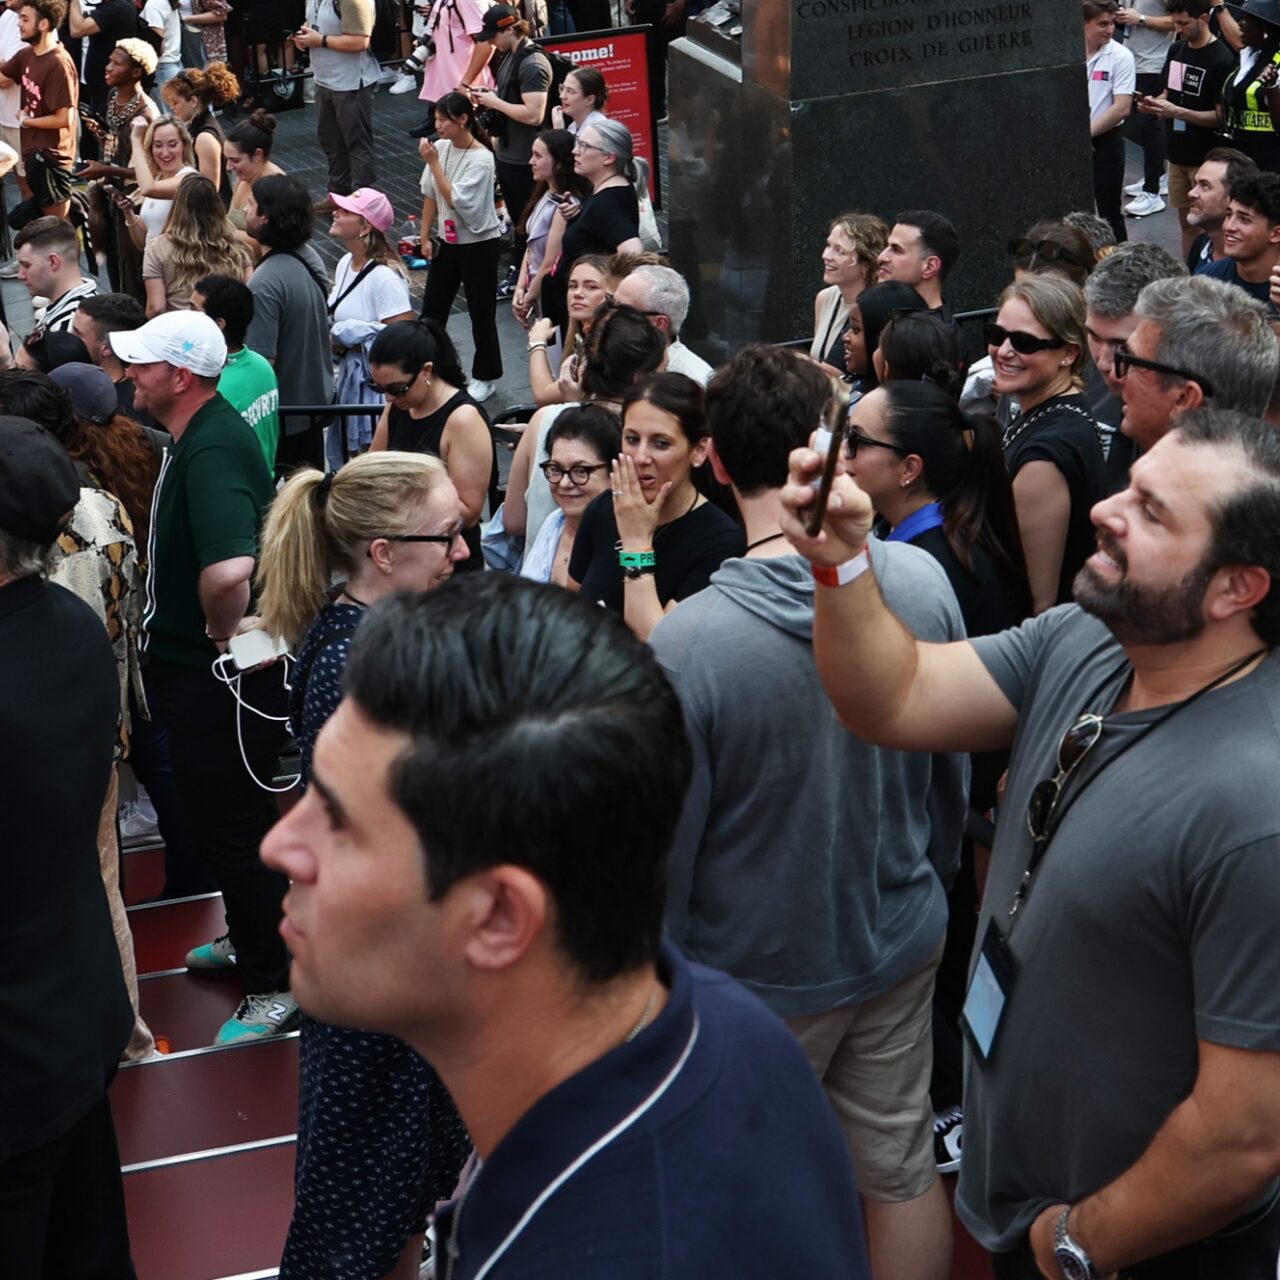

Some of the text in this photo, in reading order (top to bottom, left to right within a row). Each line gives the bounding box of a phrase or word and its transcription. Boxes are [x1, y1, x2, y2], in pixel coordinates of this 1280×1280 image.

[927, 3, 1032, 30] D'HONNEUR
[850, 30, 1032, 68] CROIX DE GUERRE
